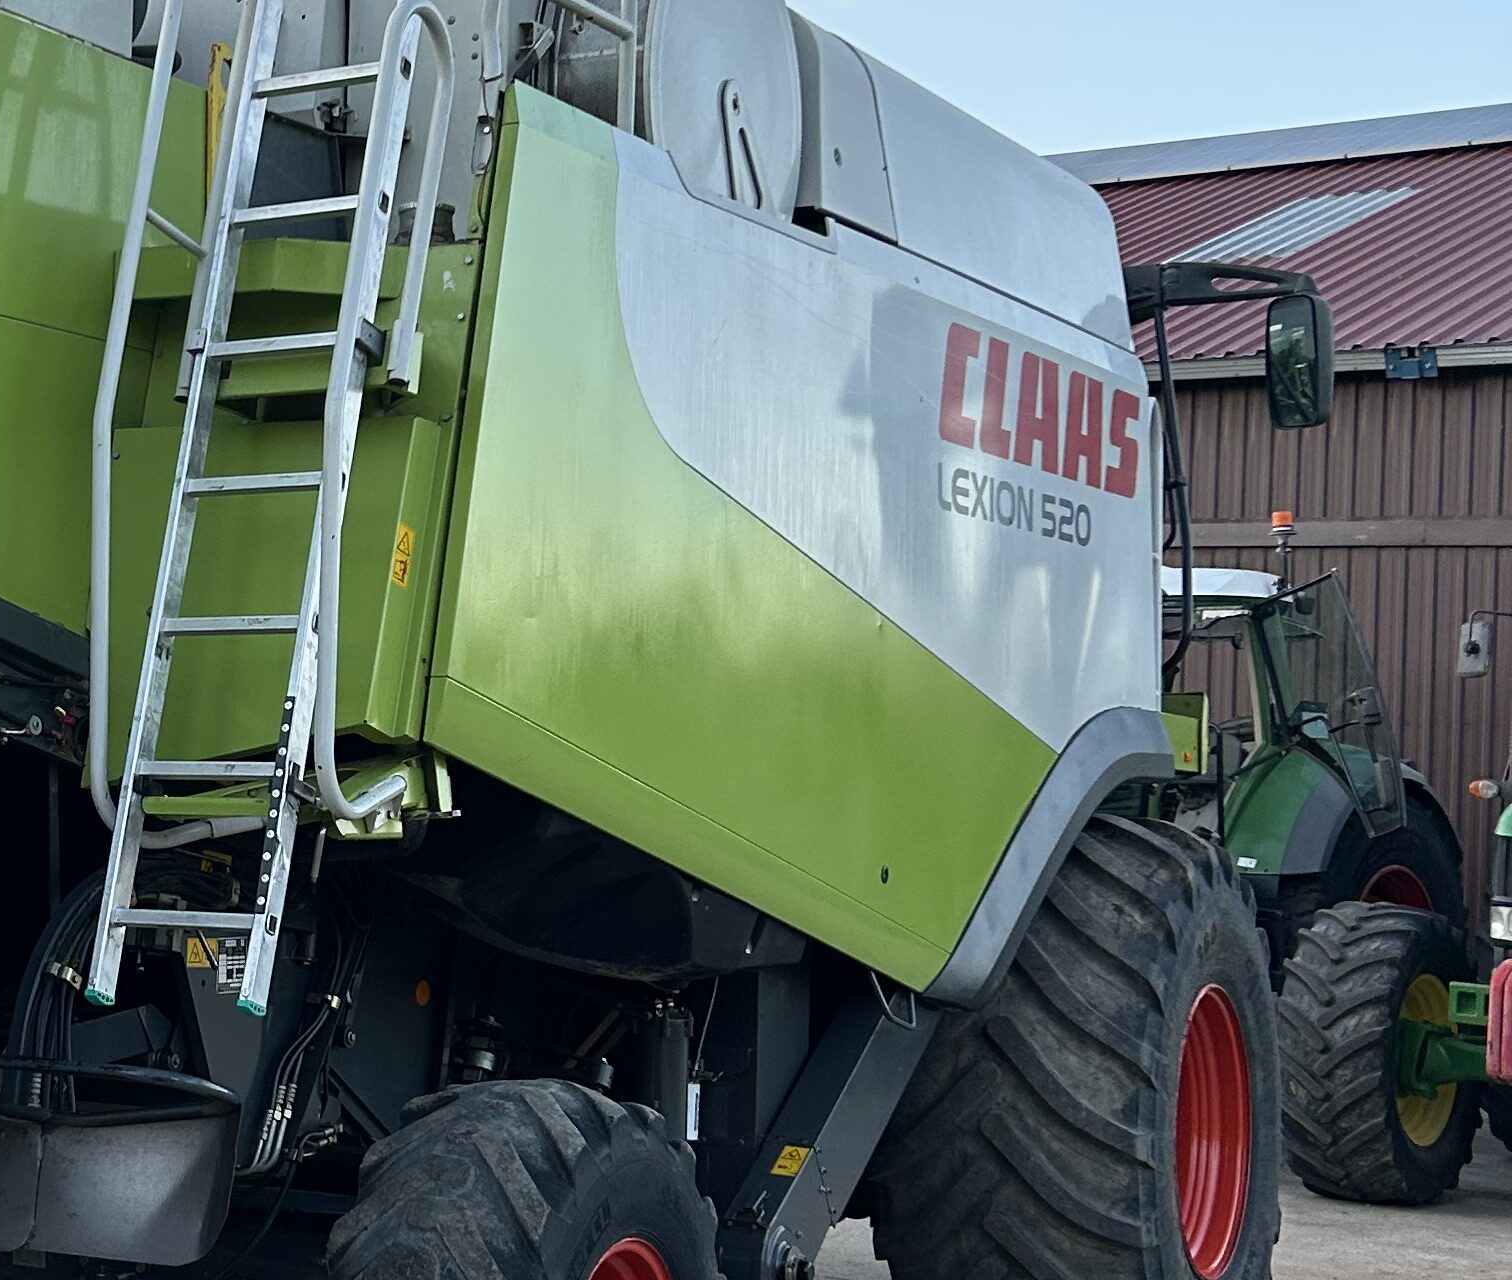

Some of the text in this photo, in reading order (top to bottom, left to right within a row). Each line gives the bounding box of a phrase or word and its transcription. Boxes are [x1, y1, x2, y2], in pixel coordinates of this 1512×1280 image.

[939, 322, 1141, 498] CLAAS
[938, 462, 1091, 547] LEXION 520
